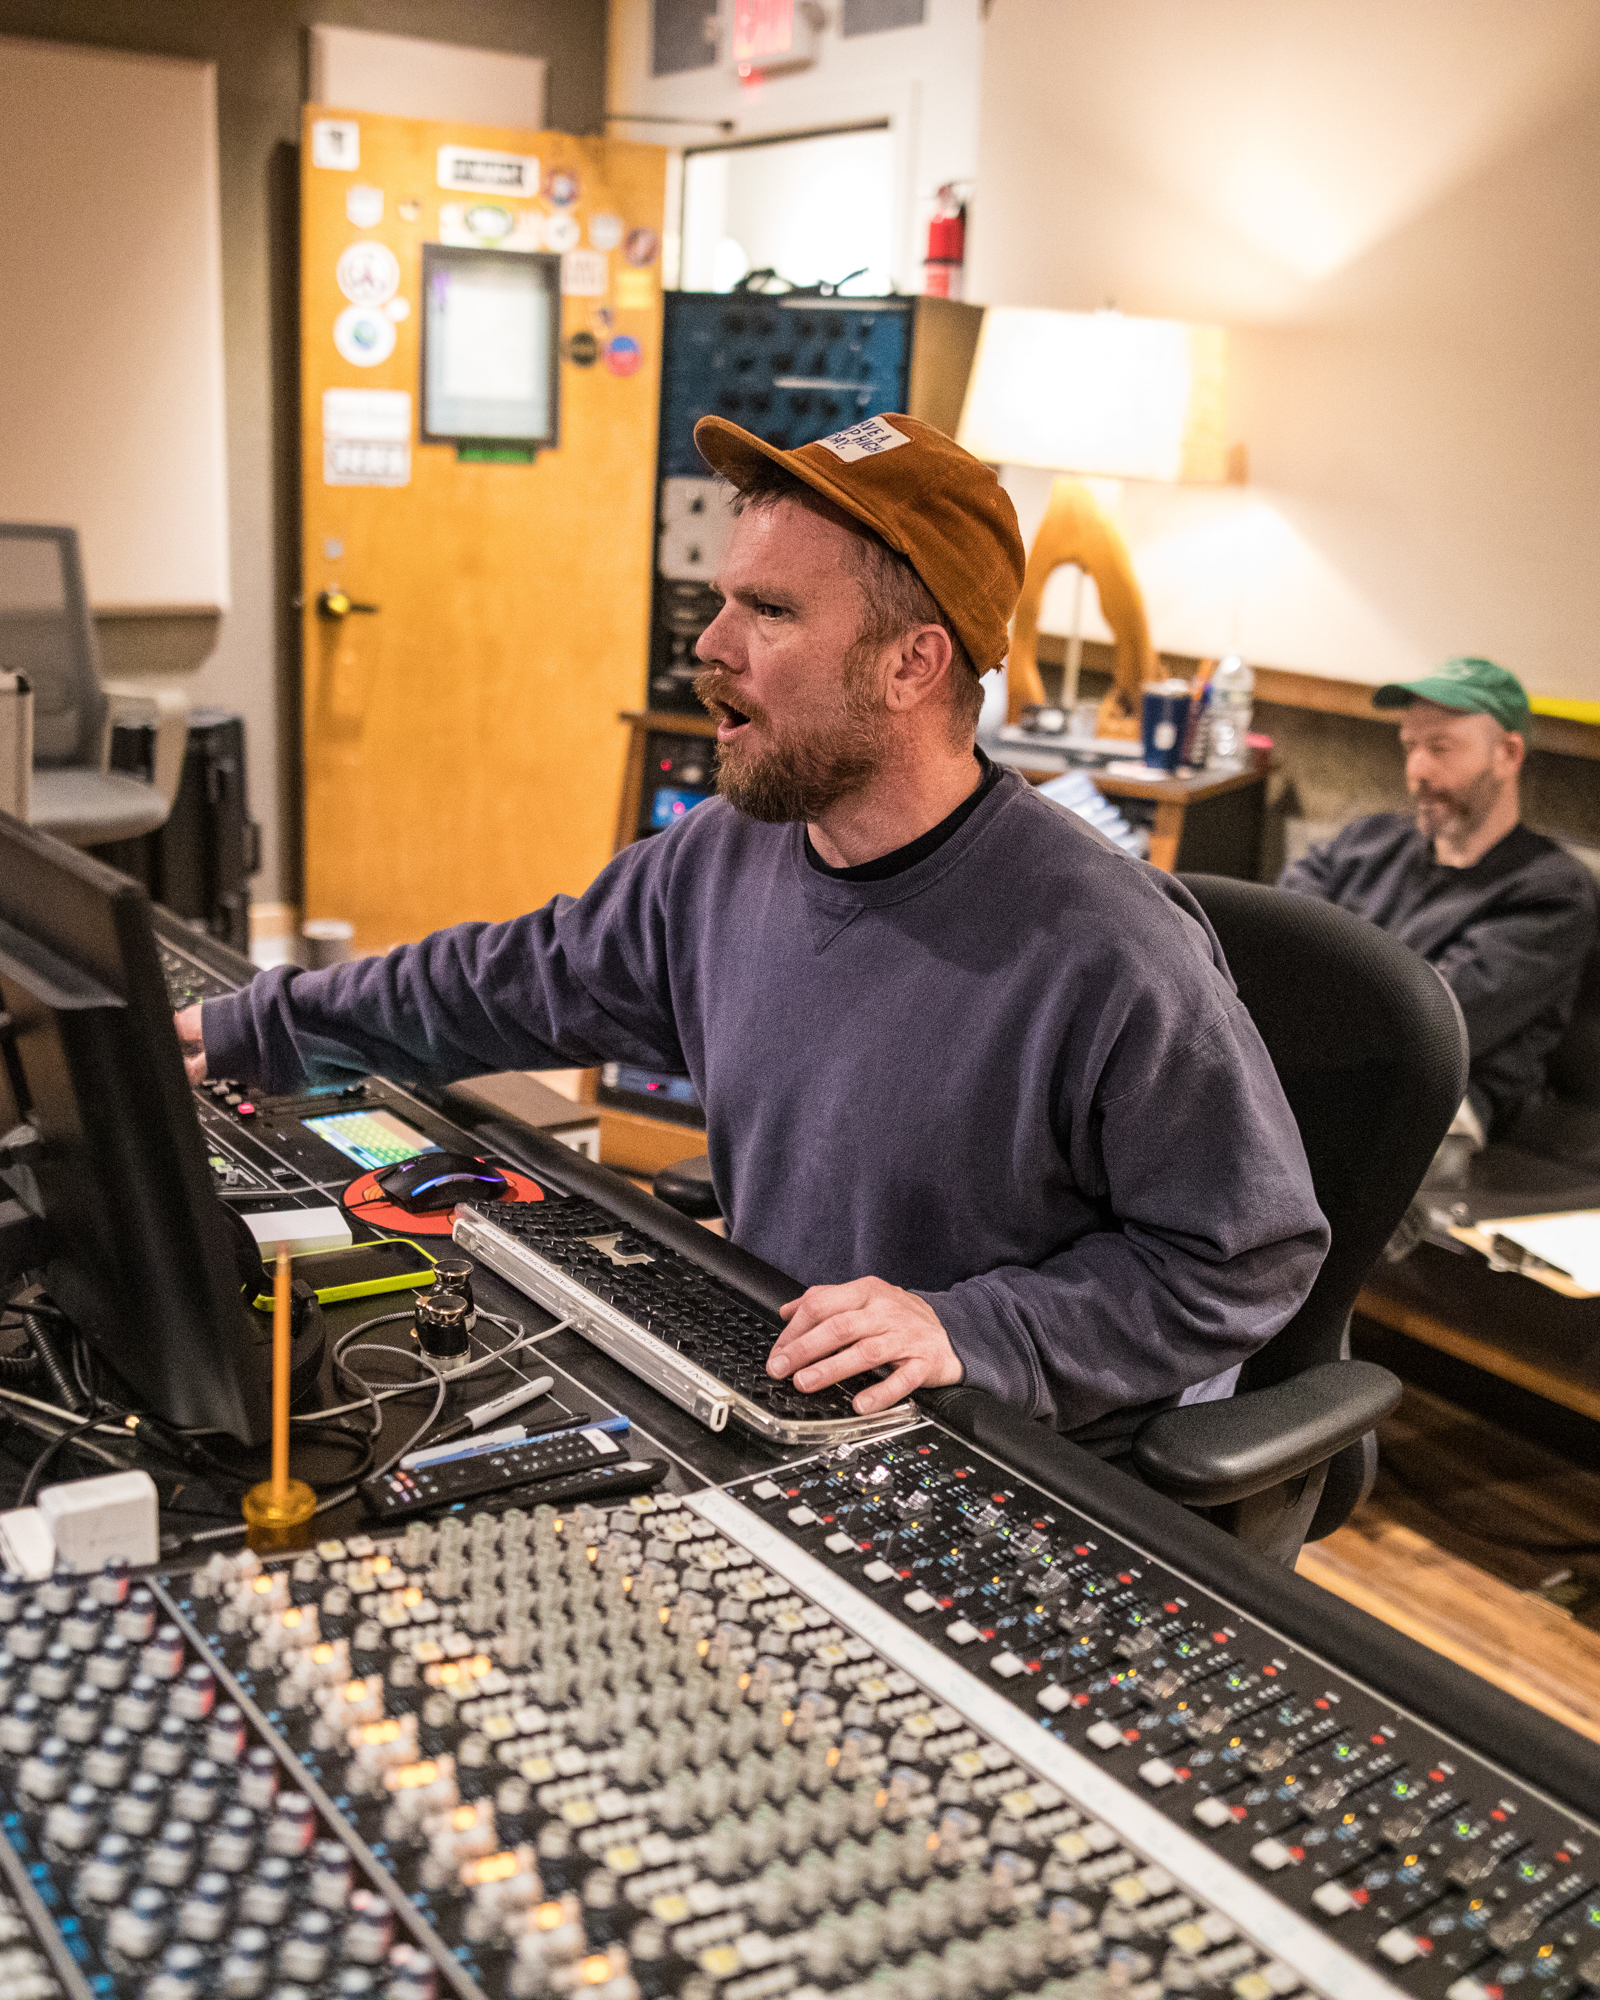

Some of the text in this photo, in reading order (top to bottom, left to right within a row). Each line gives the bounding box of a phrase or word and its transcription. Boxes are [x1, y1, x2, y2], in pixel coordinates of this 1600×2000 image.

[857, 420, 892, 443] AVE A
[851, 435, 885, 453] HIGH
[502, 1240, 518, 1251] ARE
[518, 1251, 573, 1289] PASSWORDS
[574, 1290, 591, 1301] ALL
[593, 1304, 630, 1328] DRIVES
[629, 1328, 666, 1353] UTOPIA
[668, 1354, 687, 1371] USE
